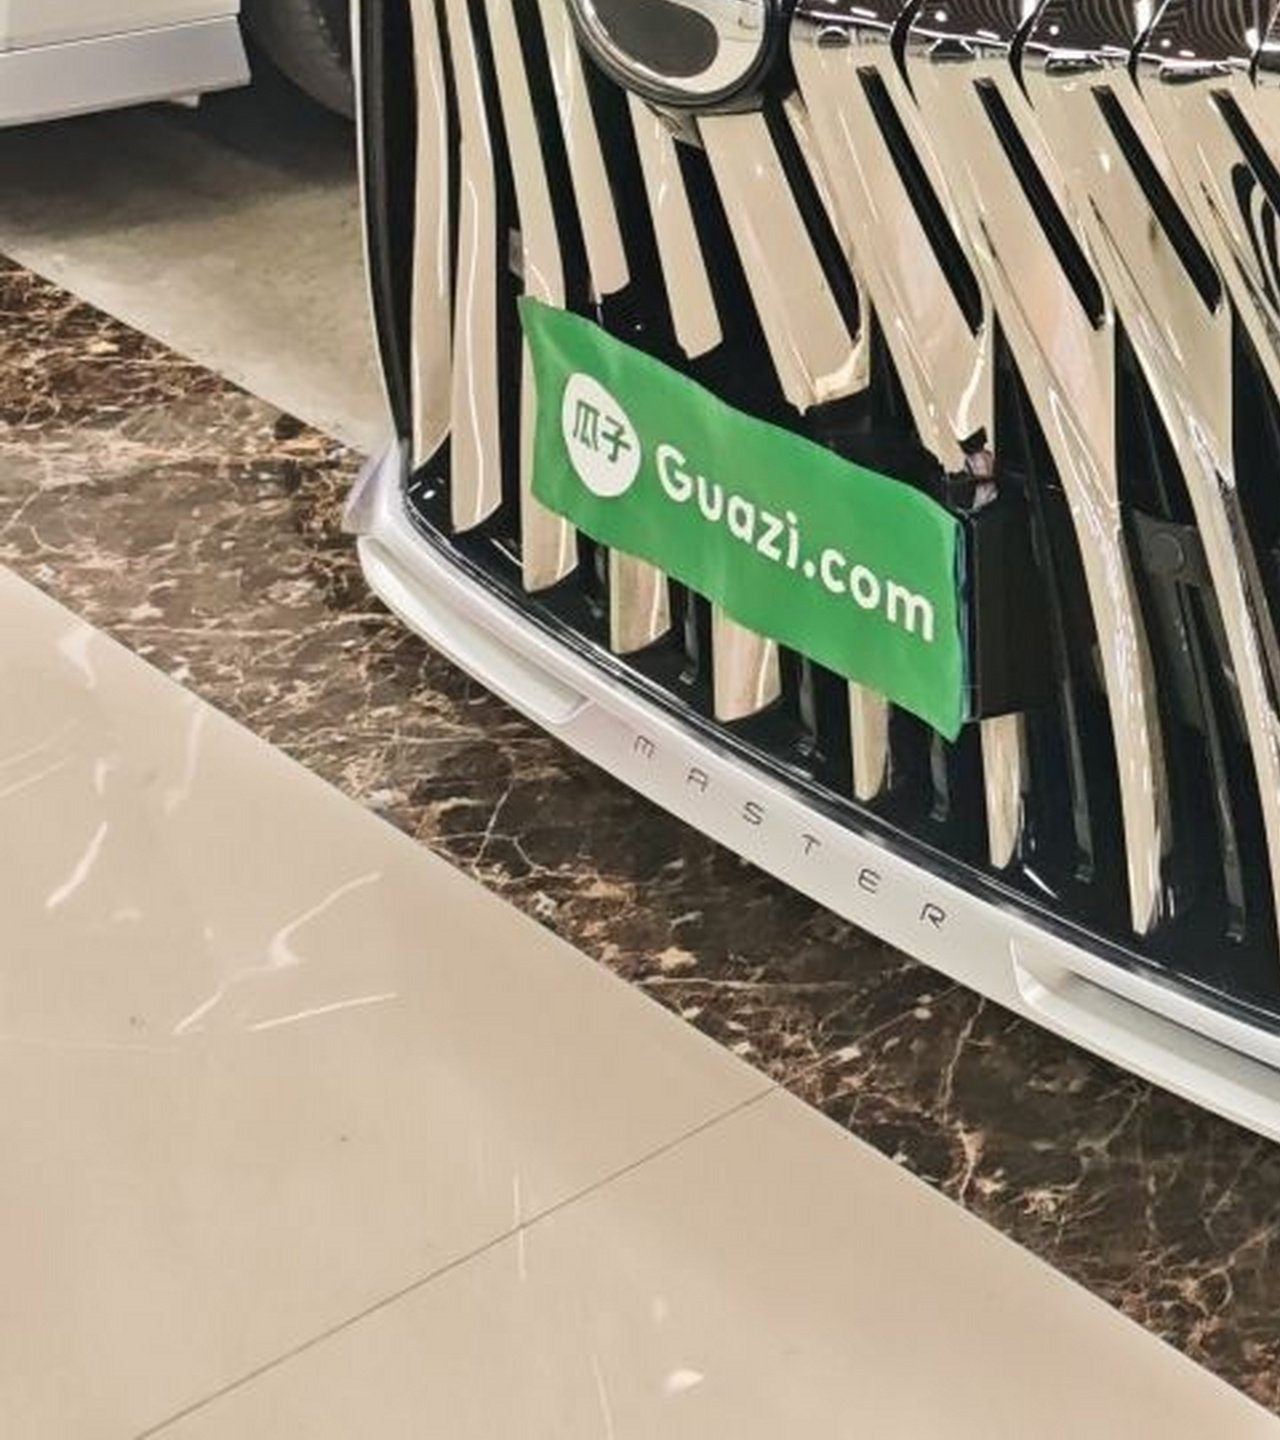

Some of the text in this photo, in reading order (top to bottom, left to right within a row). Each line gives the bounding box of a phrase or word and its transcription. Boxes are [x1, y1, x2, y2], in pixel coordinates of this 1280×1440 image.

[574, 402, 632, 464] 瓜子
[656, 444, 936, 643] Guazi.com
[633, 734, 947, 931] MASTER
